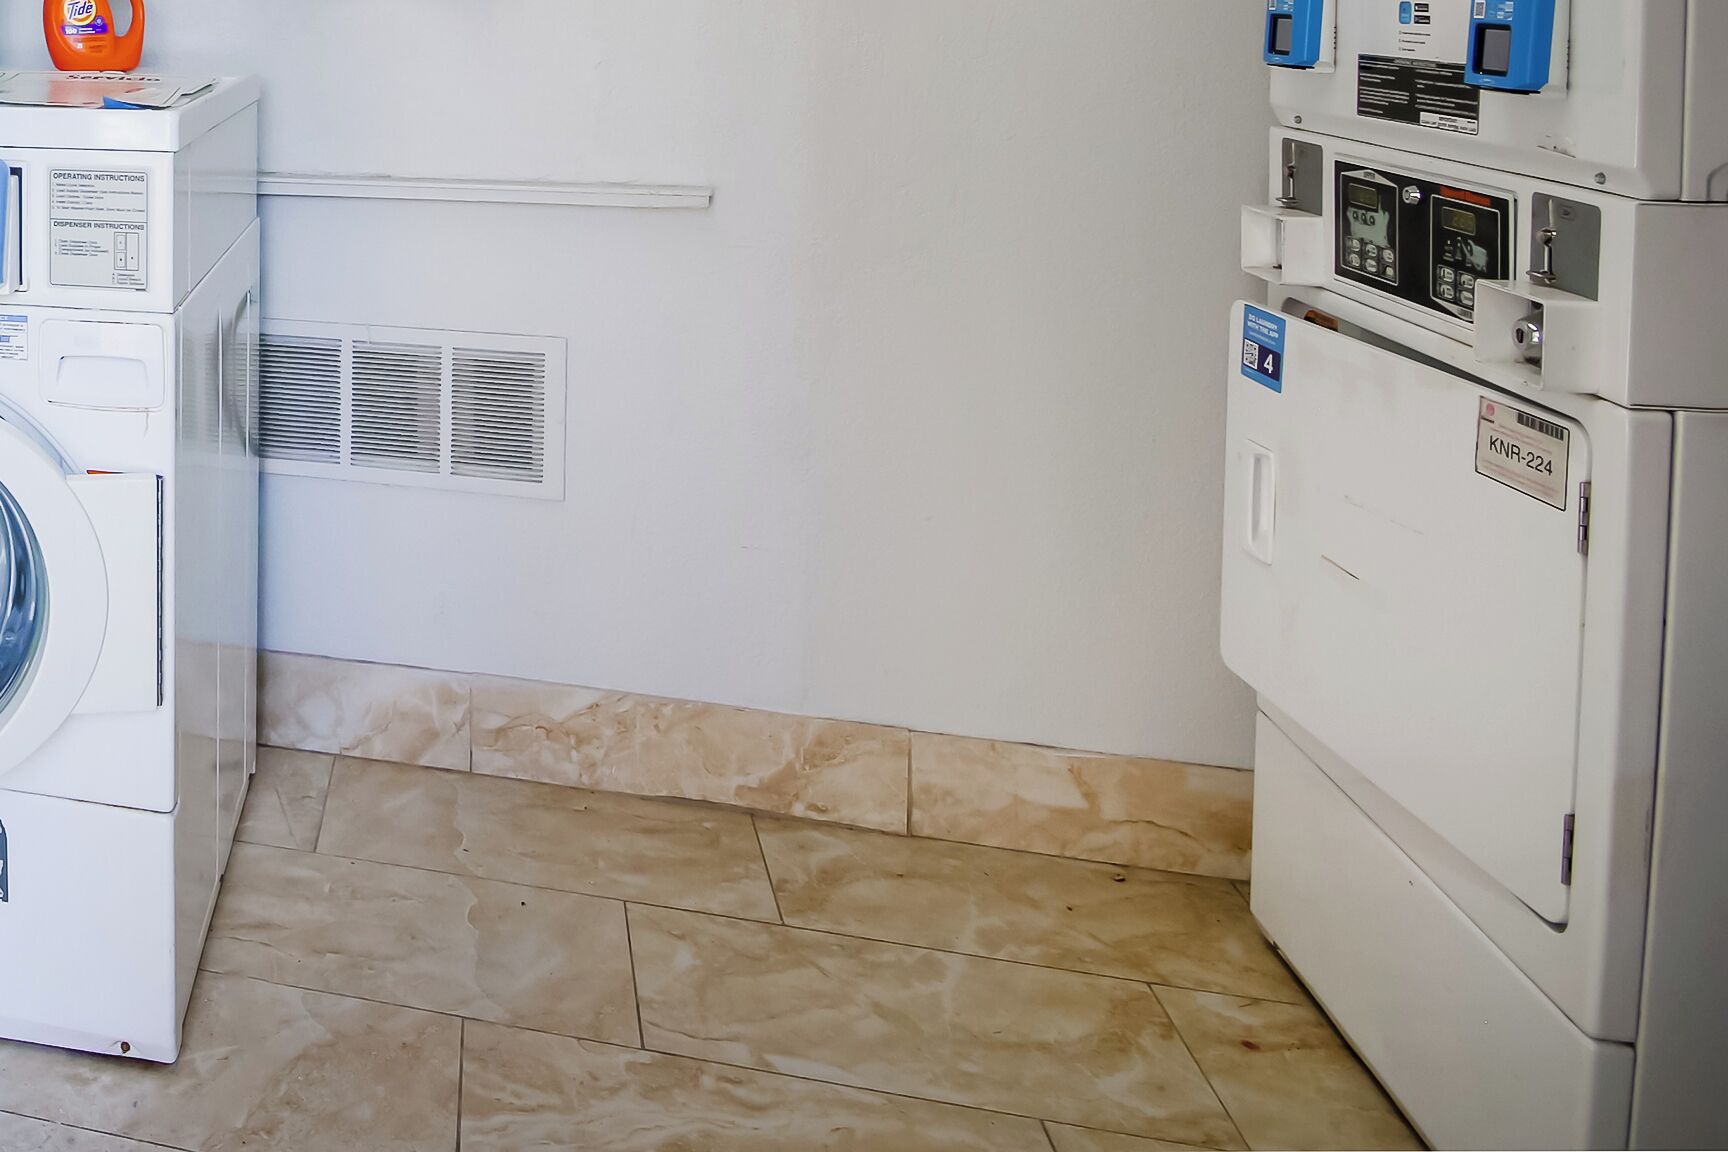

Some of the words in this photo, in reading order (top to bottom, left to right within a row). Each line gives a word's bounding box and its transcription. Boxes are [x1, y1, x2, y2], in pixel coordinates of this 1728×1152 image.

[67, 0, 93, 20] Tide
[53, 172, 92, 181] OPERATING
[93, 174, 145, 182] INSTRUCTIONS
[93, 222, 145, 230] INSTRUCTIONS
[1263, 353, 1274, 374] 4
[1489, 435, 1553, 476] KNR-224
